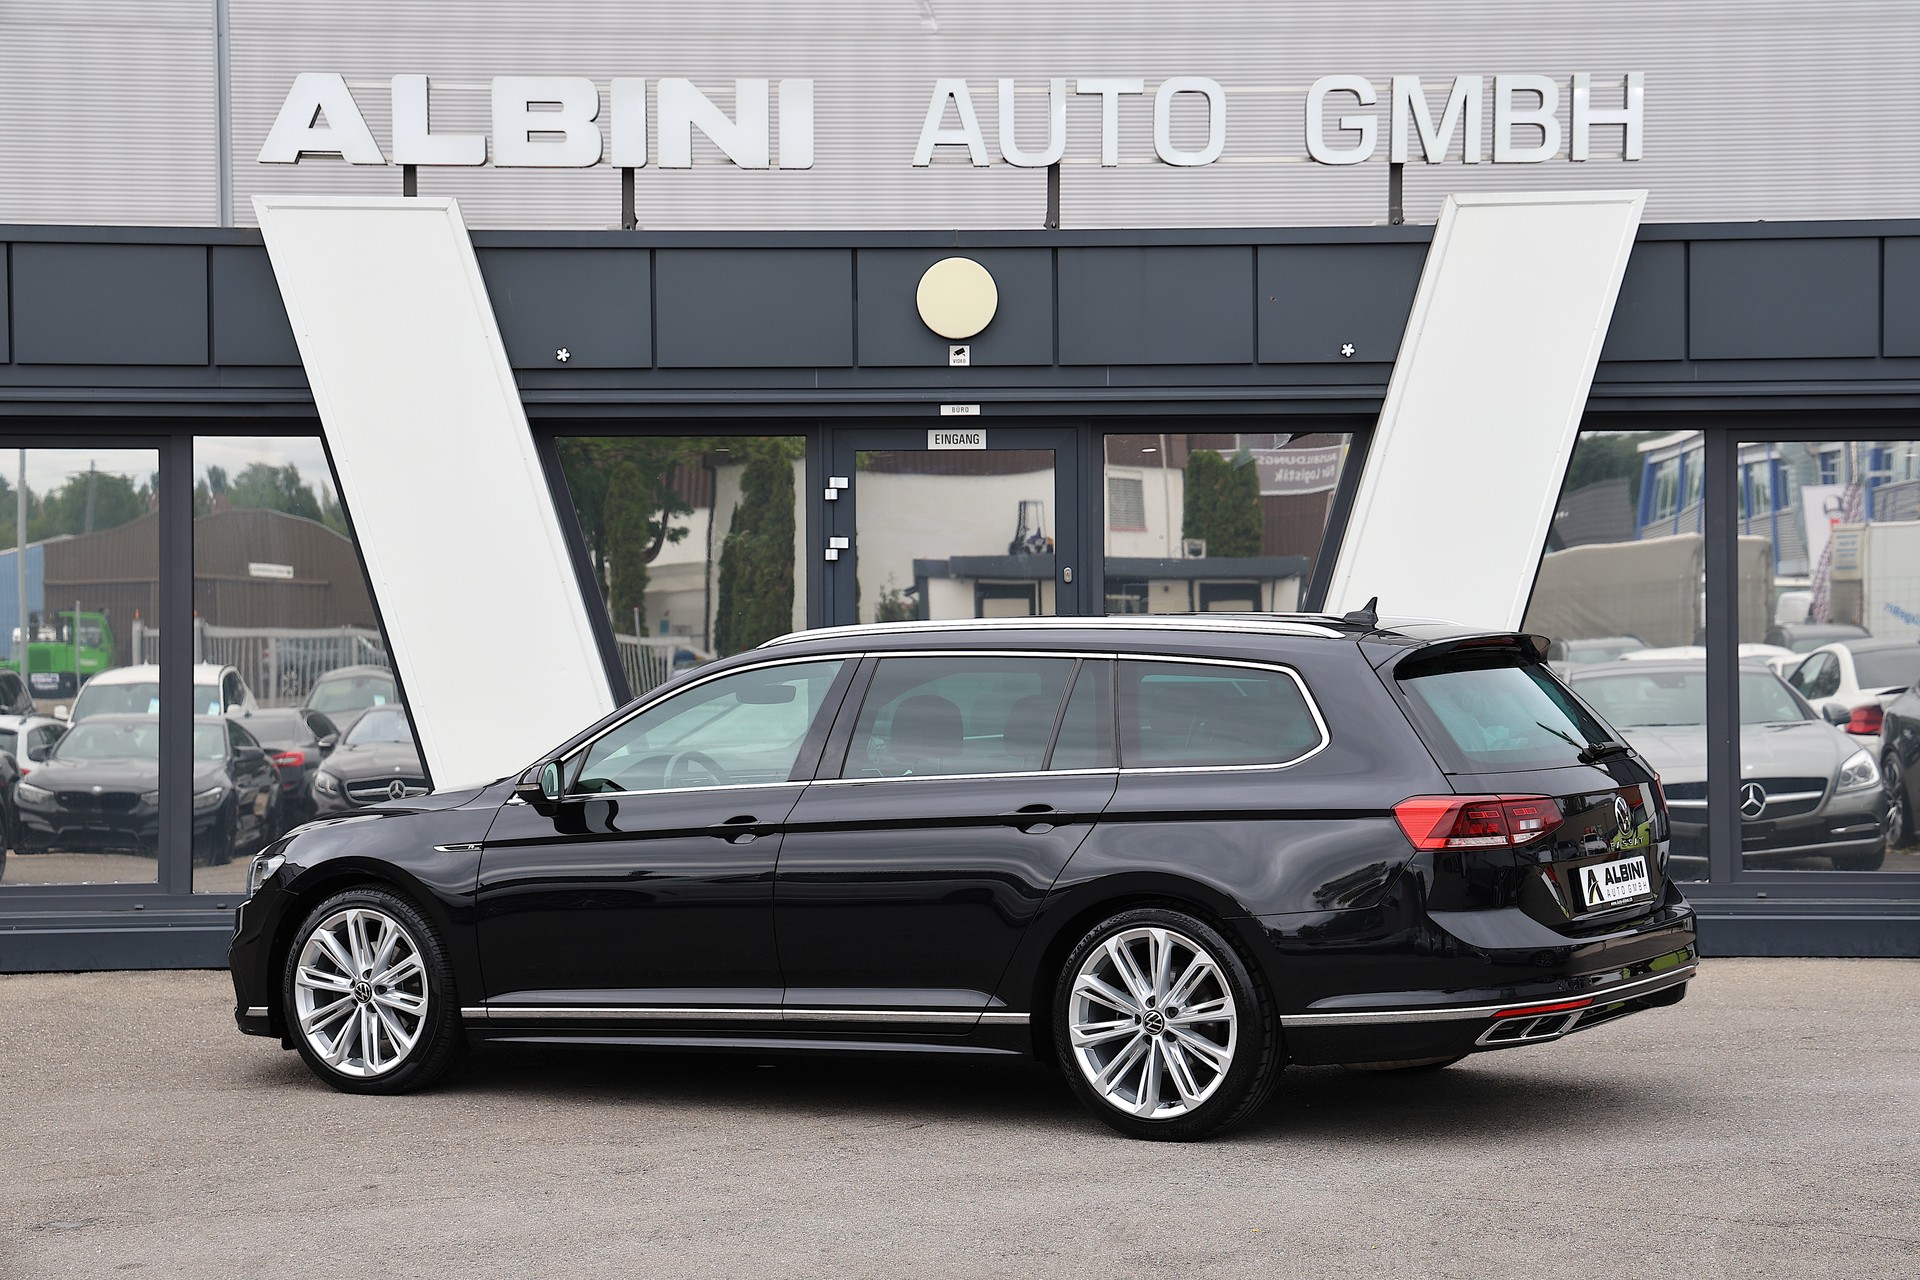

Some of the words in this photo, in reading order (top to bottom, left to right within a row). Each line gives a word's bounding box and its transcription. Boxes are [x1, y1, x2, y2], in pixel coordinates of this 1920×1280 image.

[257, 72, 814, 170] ALBINI
[912, 75, 1227, 168] AUTO
[1304, 72, 1645, 165] GMBH
[951, 405, 970, 413] BÜRO
[934, 433, 980, 445] EINGANG
[1605, 860, 1645, 886] ALBINI
[1606, 886, 1626, 897] AUTO
[1627, 881, 1648, 893] GMBH
